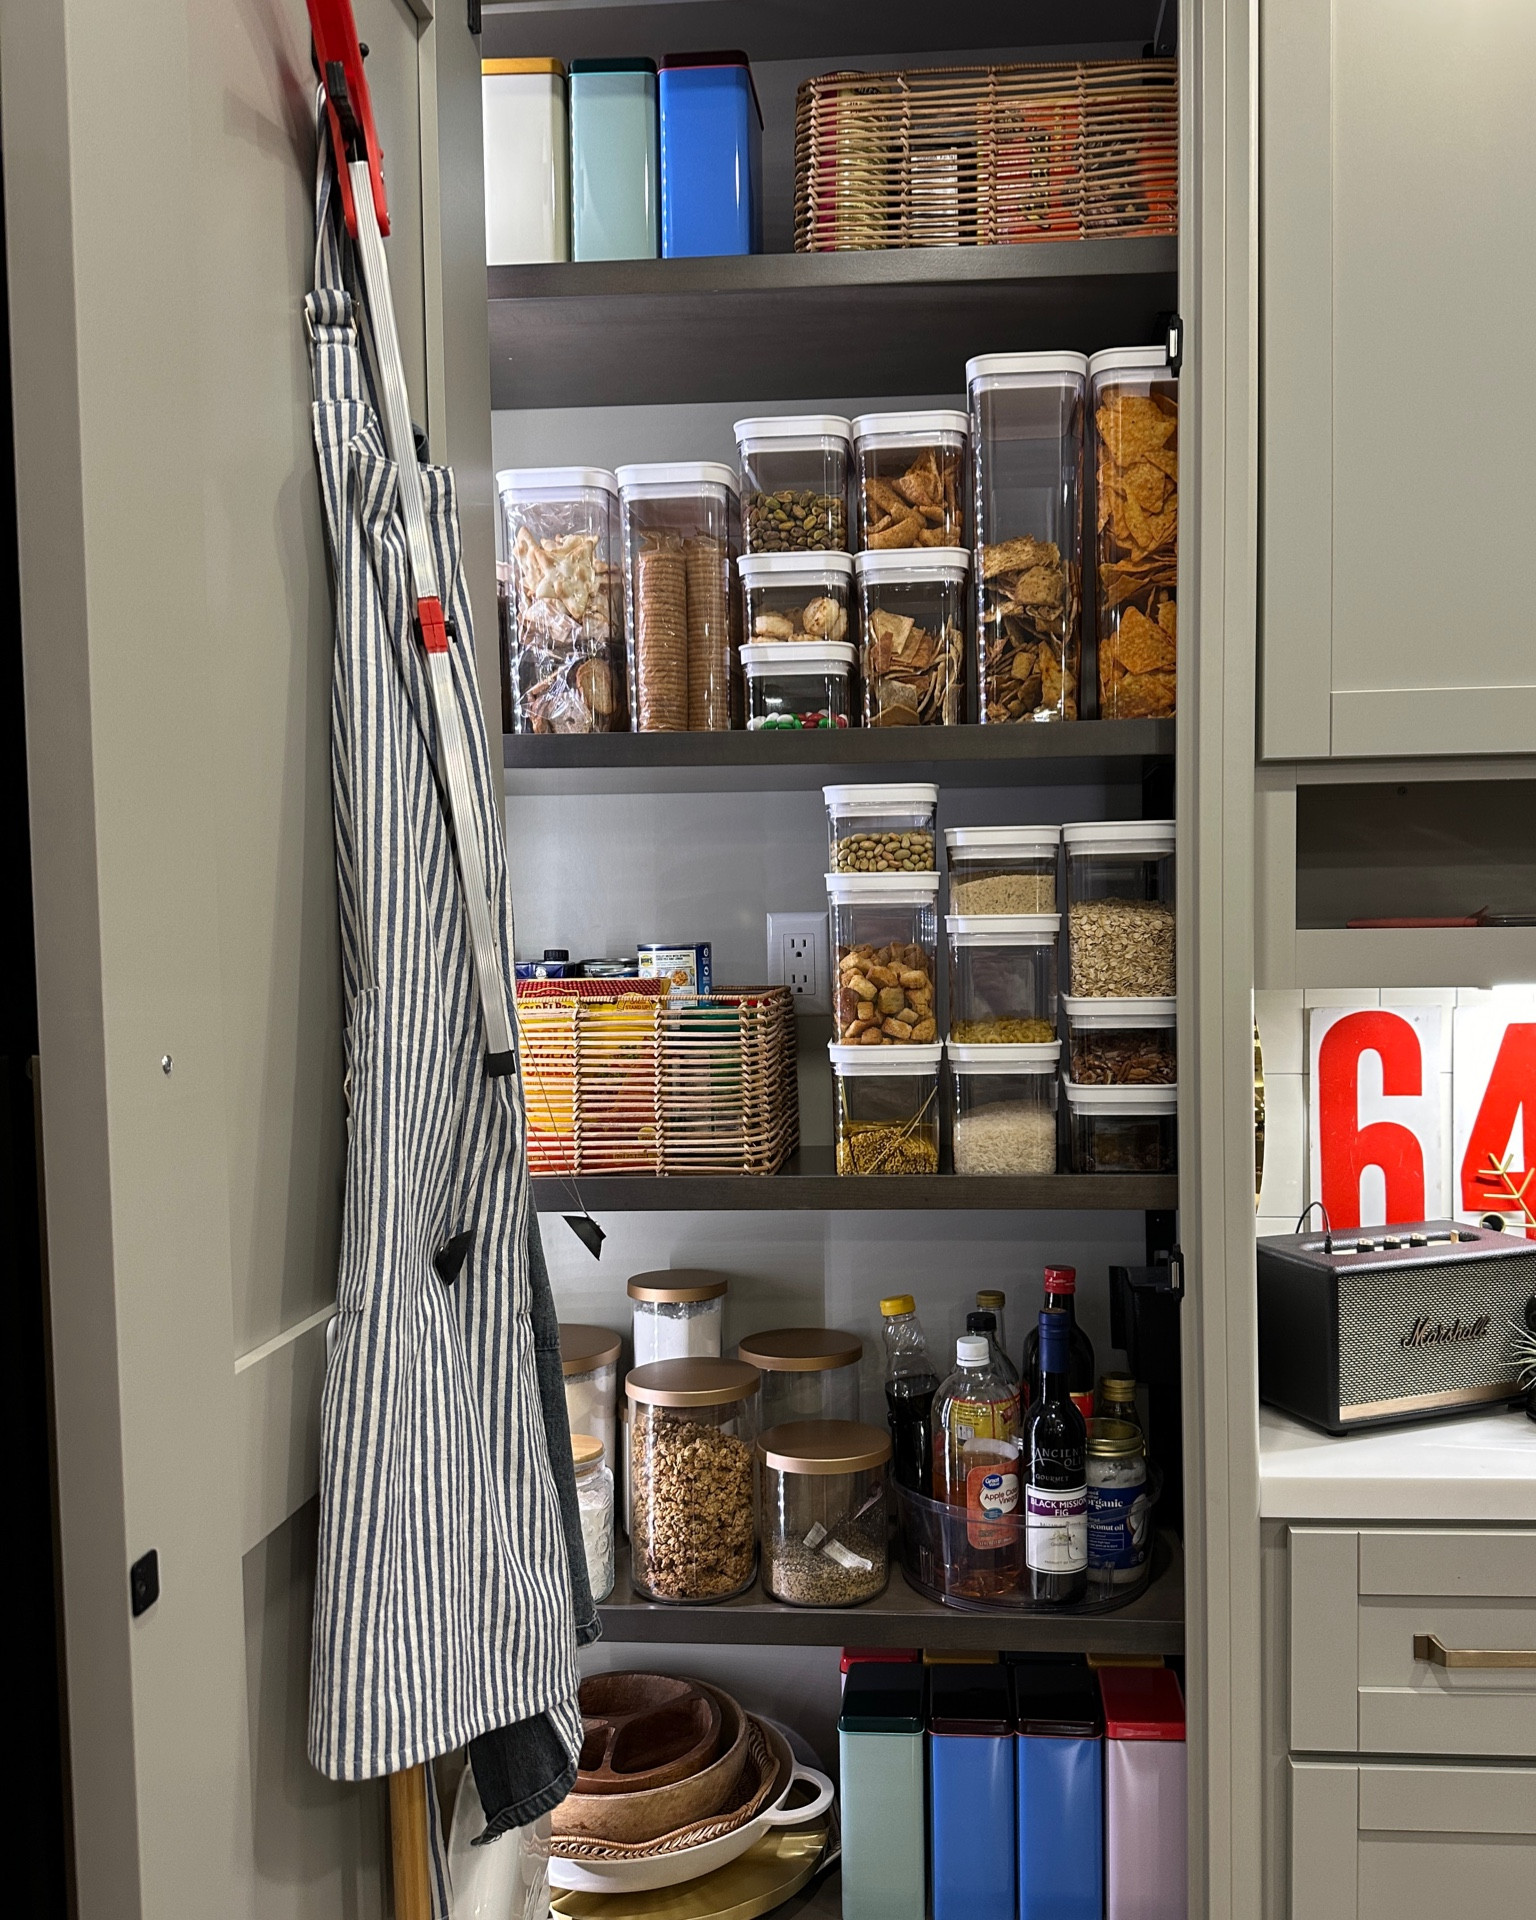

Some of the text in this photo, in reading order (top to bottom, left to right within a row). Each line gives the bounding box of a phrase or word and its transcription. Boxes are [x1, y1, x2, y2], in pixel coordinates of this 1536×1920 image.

[1402, 1316, 1491, 1348] Marshall
[1035, 1473, 1070, 1482] GOURMET
[984, 1492, 1005, 1501] Apple
[1030, 1497, 1087, 1509] BLACK MISSION
[1054, 1508, 1069, 1517] FIG
[1114, 1523, 1124, 1531] oil
